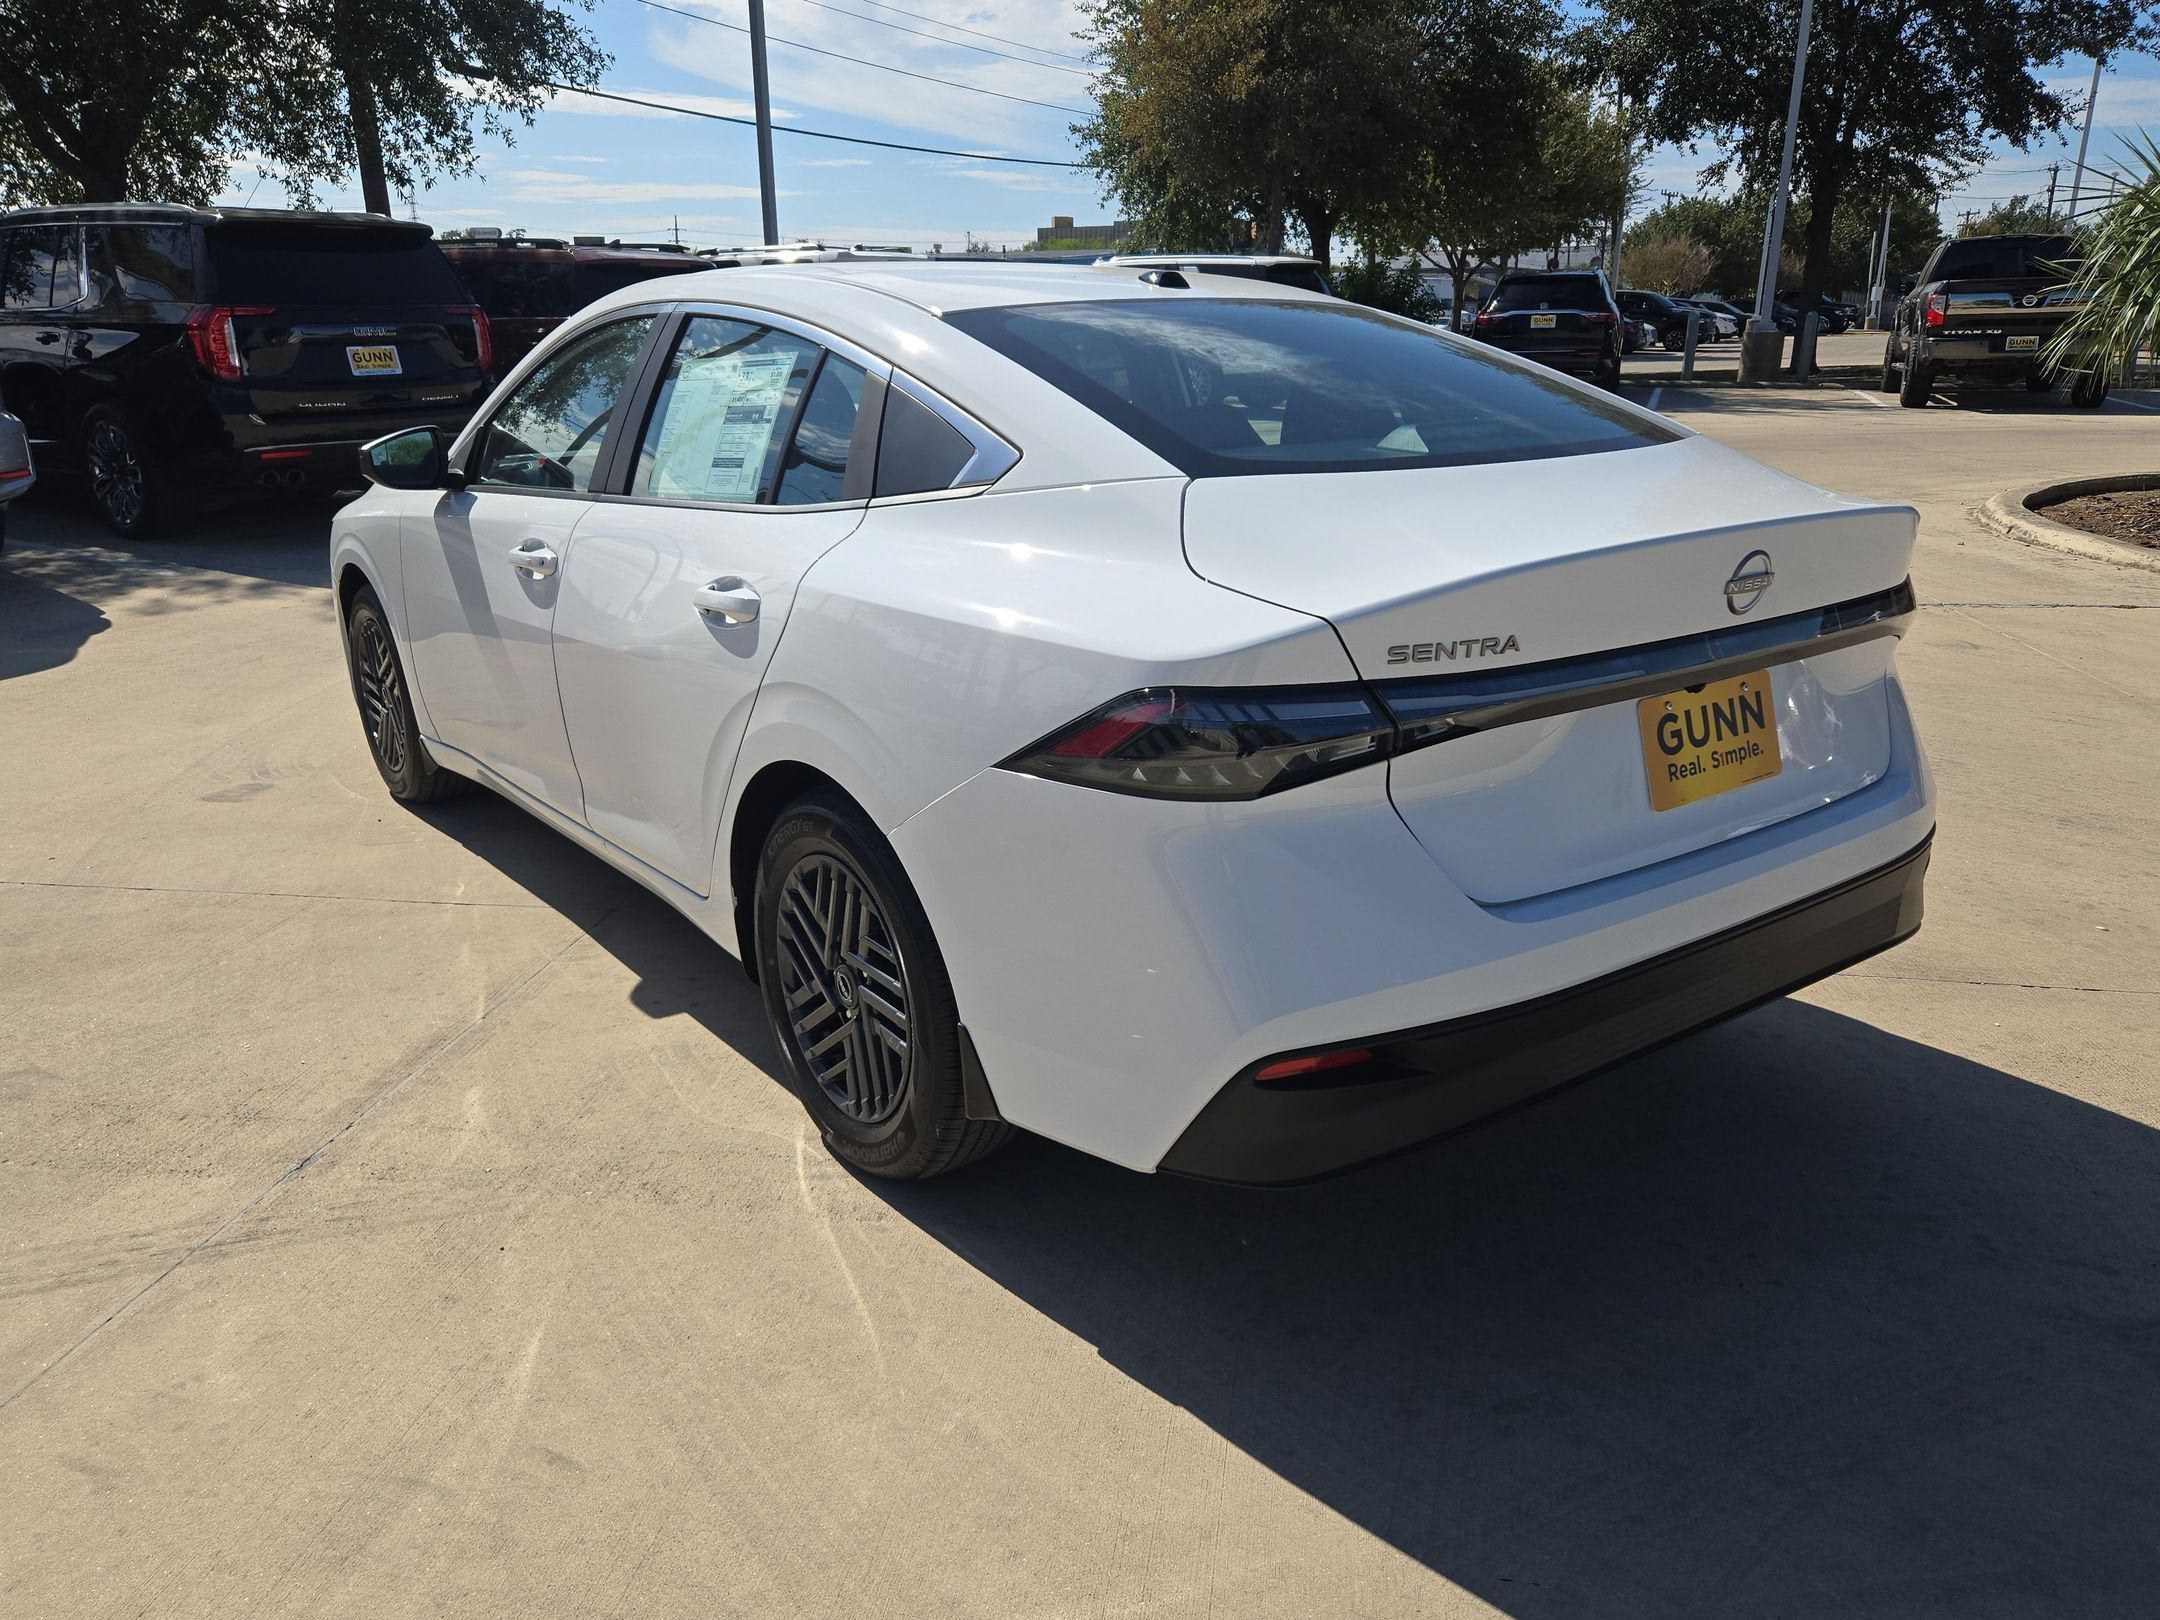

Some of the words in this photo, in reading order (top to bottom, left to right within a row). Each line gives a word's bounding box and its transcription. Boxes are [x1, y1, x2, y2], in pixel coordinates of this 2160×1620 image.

[353, 327, 397, 337] GMC
[352, 352, 394, 363] GUNN
[1387, 634, 1520, 665] SENTRA
[1657, 690, 1766, 756] GUNN
[1667, 755, 1707, 782] Real.
